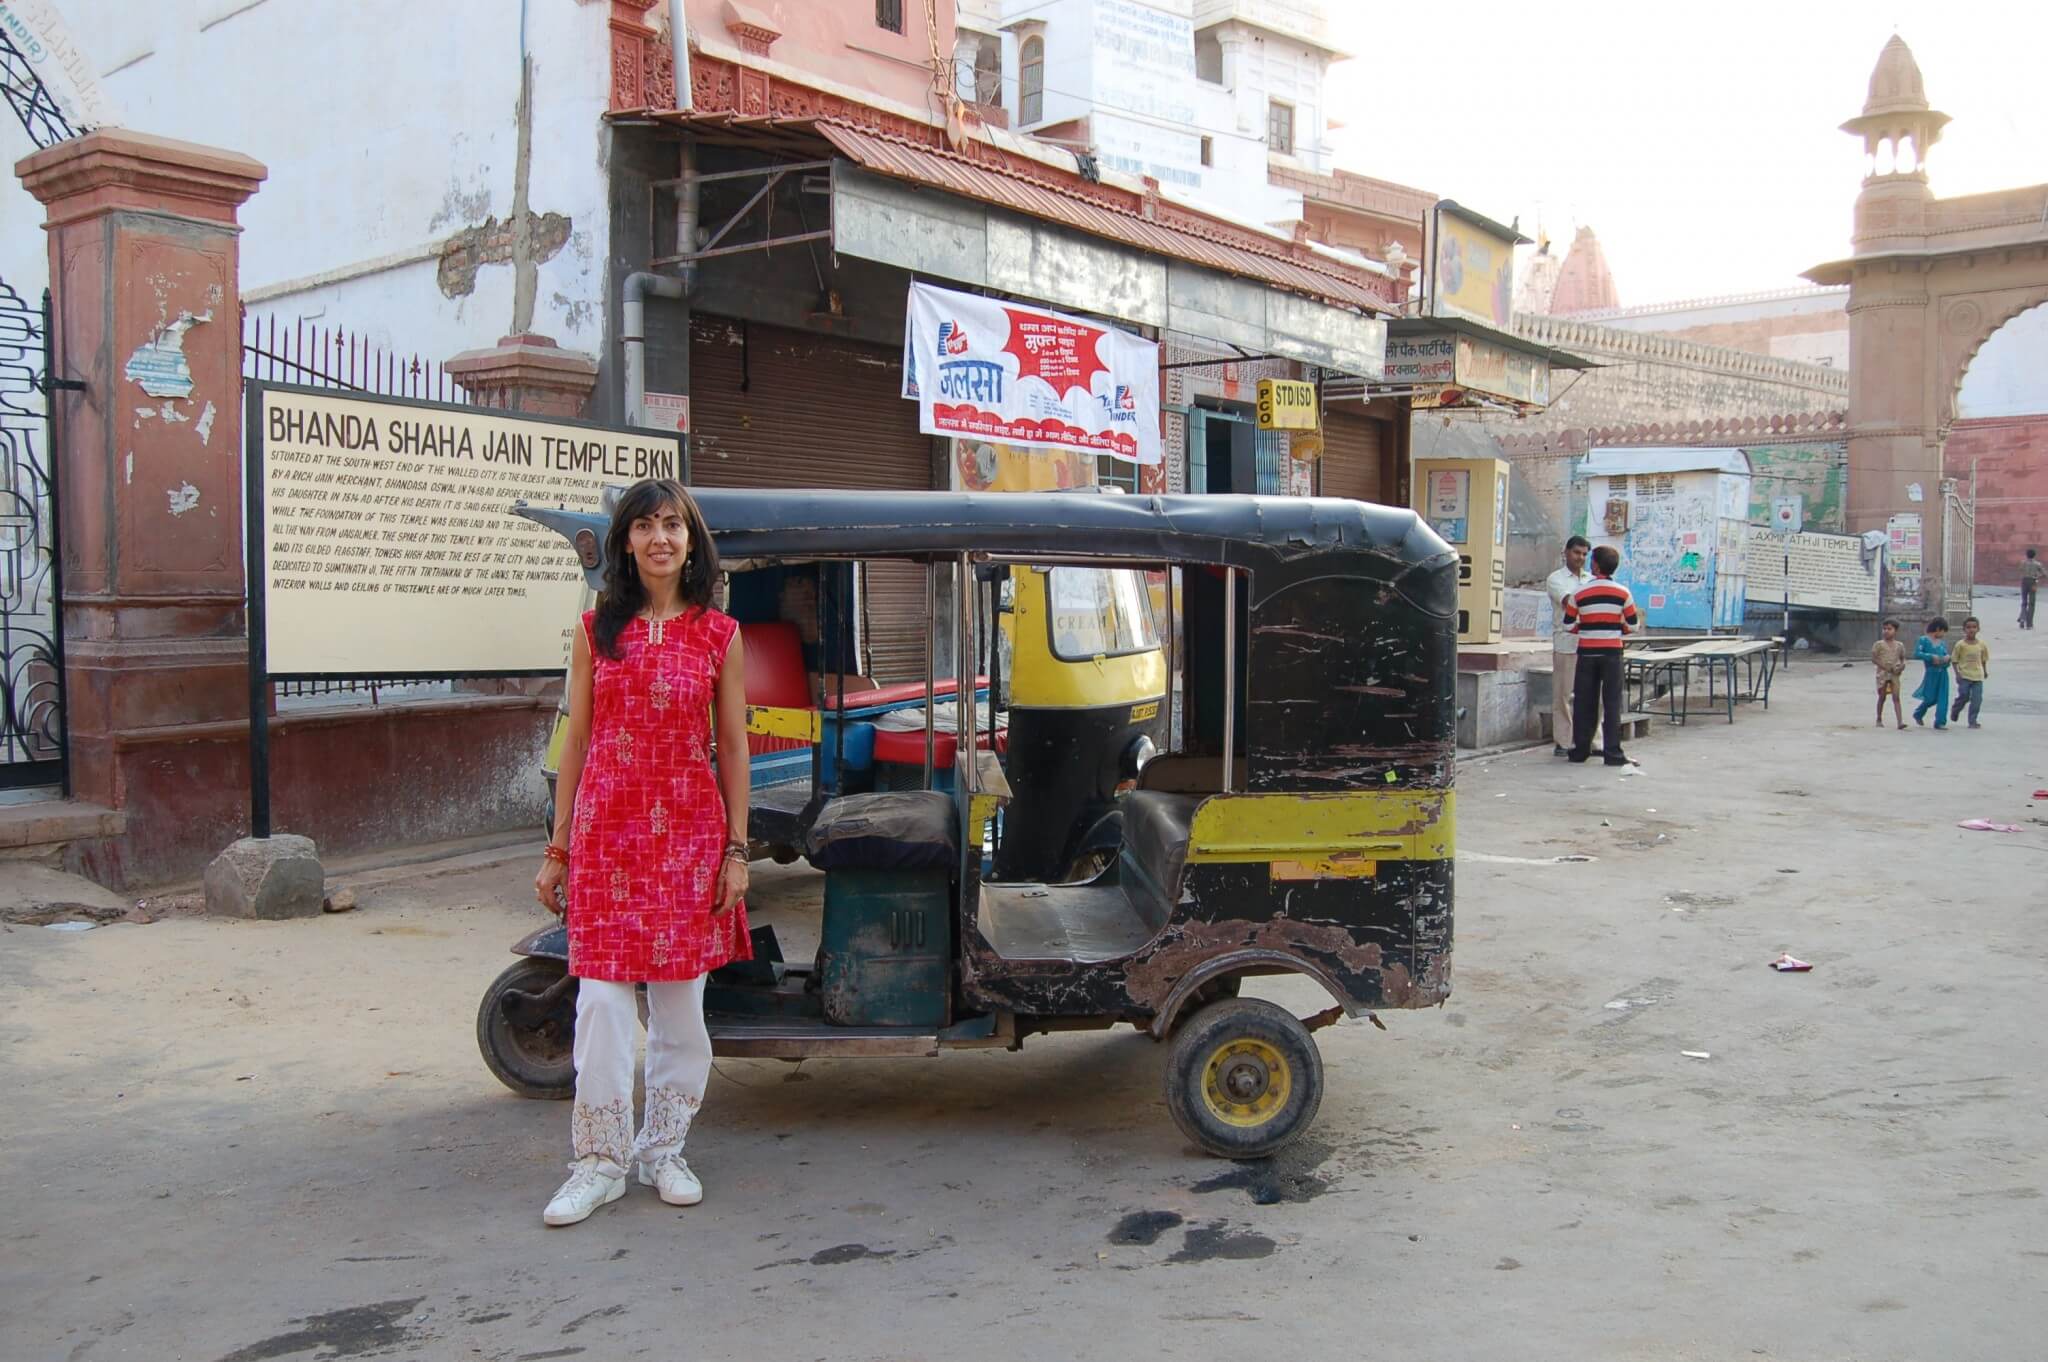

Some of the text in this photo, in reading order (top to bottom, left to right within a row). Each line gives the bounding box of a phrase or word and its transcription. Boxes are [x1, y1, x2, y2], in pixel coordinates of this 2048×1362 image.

[1259, 388, 1271, 424] PCO
[1275, 384, 1312, 407] STD/ISD
[269, 406, 379, 451] BHANDA
[388, 419, 474, 460] SHAHA
[482, 430, 532, 467] JAIN
[270, 450, 312, 463] SITUATED
[311, 453, 324, 464] AT
[326, 455, 342, 467] THE
[396, 461, 414, 473] END
[428, 463, 446, 475] THE
[447, 466, 479, 479] WALLED
[499, 472, 507, 481] IS
[508, 472, 521, 482] THE
[520, 473, 546, 485] OLDEST
[547, 477, 561, 486] JAIN
[563, 477, 591, 489] TEMPLE
[592, 481, 600, 489] IN
[271, 469, 283, 480] BY
[283, 470, 291, 480] A
[291, 470, 314, 482] RICH
[314, 473, 335, 484] JAIN
[384, 478, 428, 491] BHANDASA
[430, 482, 457, 494] OSWAL
[457, 484, 467, 494] IN
[553, 493, 568, 503] WAS
[568, 493, 600, 505] FOUNDED
[271, 488, 286, 498] HIS
[288, 488, 328, 501] DAUGHTER
[330, 492, 340, 501] IN
[360, 494, 373, 504] AD
[373, 495, 401, 506] AFTER
[400, 496, 414, 506] HIS
[443, 499, 454, 509] IT
[453, 500, 462, 510] IS
[463, 501, 480, 512] SAID
[271, 505, 297, 517] WHILE
[299, 507, 315, 518] THE
[315, 508, 363, 520] FOUNDATION
[364, 512, 376, 521] OF
[379, 513, 398, 523] THIS
[400, 514, 428, 526] TEMPLE
[430, 517, 448, 527] WAS
[447, 517, 469, 528] BEING
[468, 519, 485, 529] LAID
[486, 520, 500, 530] AND
[502, 520, 516, 531] THE
[516, 521, 540, 532] STONES
[272, 523, 284, 535] ALL
[285, 524, 299, 536] THE
[298, 525, 315, 536] WAY
[315, 526, 338, 537] FROM
[381, 530, 397, 541] THE
[397, 531, 419, 543] SPIRE
[418, 533, 429, 543] OF
[430, 533, 447, 543] THIS
[449, 534, 476, 546] TEMPLE
[477, 536, 495, 546] WITH
[537, 540, 551, 550] AND
[1821, 538, 1860, 552] TEMPLE
[272, 542, 290, 553] AND
[290, 543, 304, 553] ITS
[305, 544, 331, 555] GILDED
[374, 547, 403, 559] TOWERS
[403, 549, 423, 560] HIGH
[423, 550, 447, 561] ABOVE
[449, 551, 462, 562] THE
[481, 553, 492, 563] OF
[493, 553, 506, 563] THE
[507, 554, 523, 565] CITY
[524, 555, 540, 566] AND
[540, 556, 554, 566] CAN
[272, 560, 311, 573] DEDICATED
[312, 562, 323, 572] TO
[324, 562, 368, 574] SUMTINATH
[380, 565, 395, 576] THE
[395, 565, 417, 576] FIFTH
[419, 566, 462, 578] TIRTHANKAR
[463, 568, 474, 578] OF
[475, 568, 489, 579] THE
[512, 569, 526, 580] THE
[525, 570, 560, 581] PAINTINGS
[560, 571, 579, 582] FROM
[272, 578, 306, 590] INTERIOR
[308, 580, 332, 591] WALLS
[333, 581, 350, 591] AND
[382, 583, 393, 592] OF
[436, 585, 451, 594] ARE
[450, 585, 460, 594] OF
[461, 586, 483, 595] MUCH
[484, 586, 506, 596] LATER
